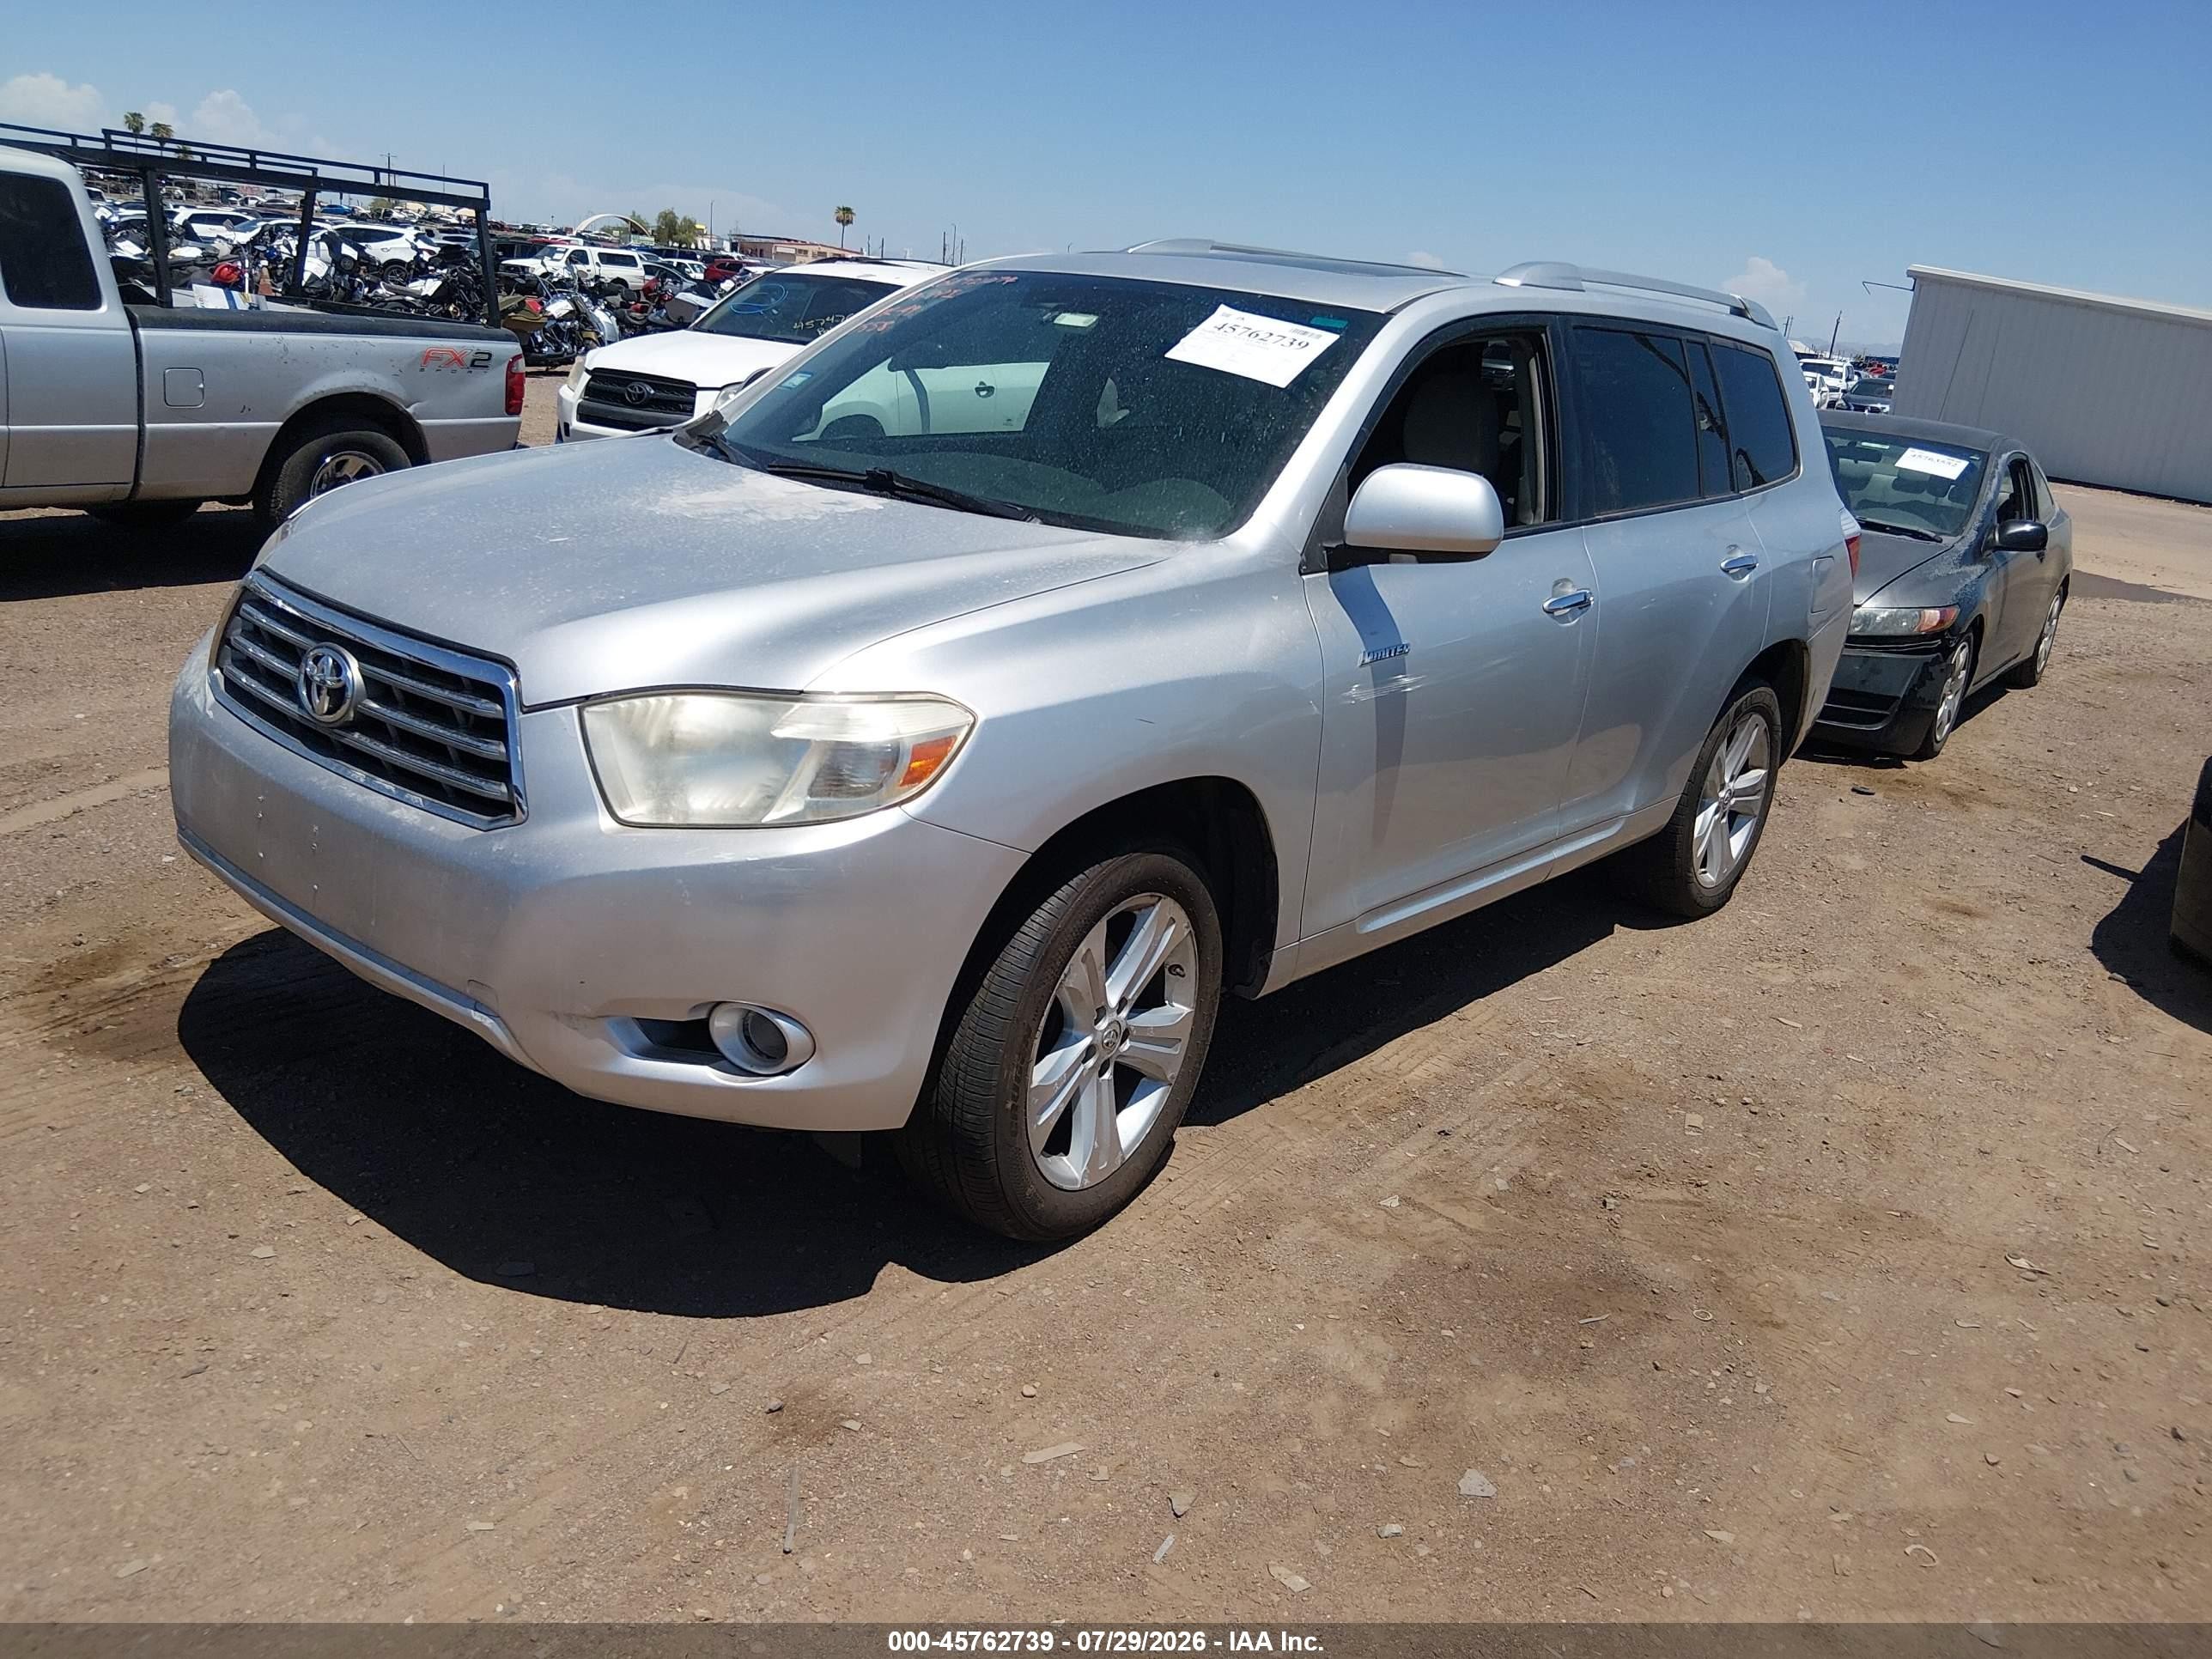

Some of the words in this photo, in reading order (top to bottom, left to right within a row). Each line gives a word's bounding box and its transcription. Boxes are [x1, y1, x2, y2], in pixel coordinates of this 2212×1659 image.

[1213, 322, 1310, 349] 45762739
[420, 346, 493, 368] FX2
[1357, 642, 1410, 667] LIMITED
